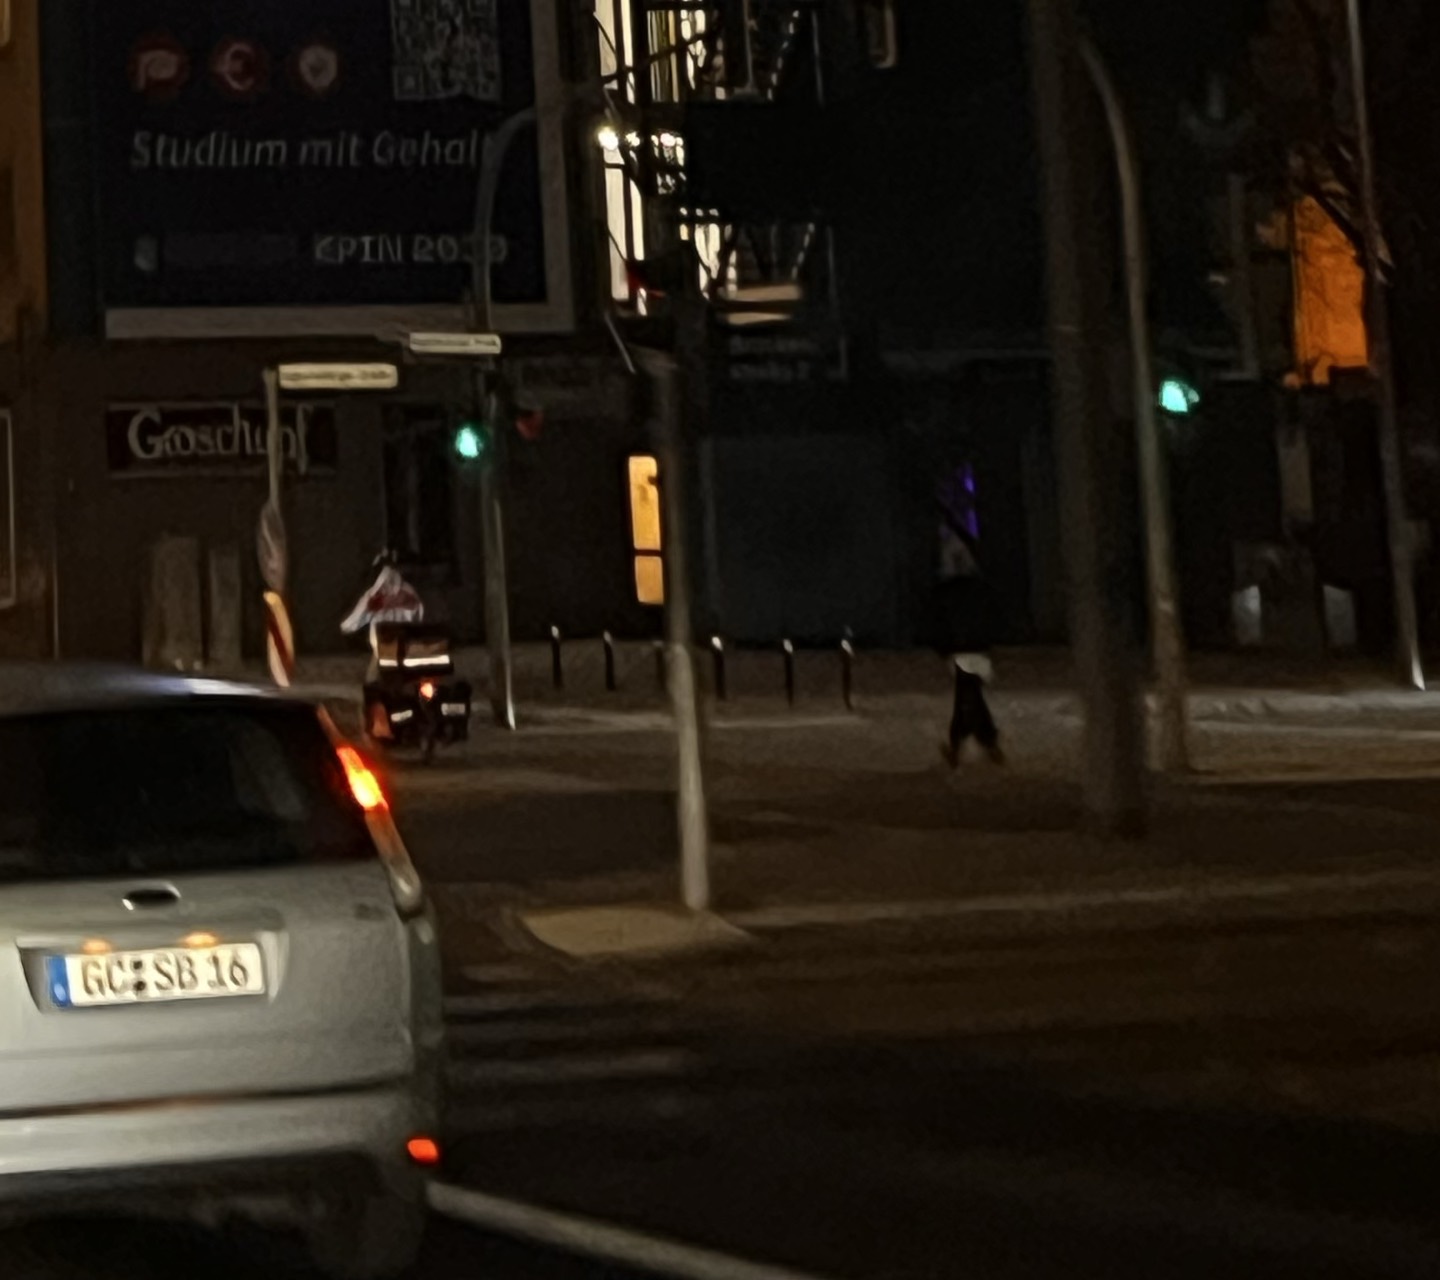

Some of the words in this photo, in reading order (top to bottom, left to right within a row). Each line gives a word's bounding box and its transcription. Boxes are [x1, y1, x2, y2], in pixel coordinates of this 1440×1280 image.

[131, 130, 287, 168] Studium
[299, 130, 361, 168] mit
[371, 128, 492, 168] Gehal
[81, 958, 125, 996] GC
[153, 952, 198, 991] SB
[208, 952, 250, 988] 16
